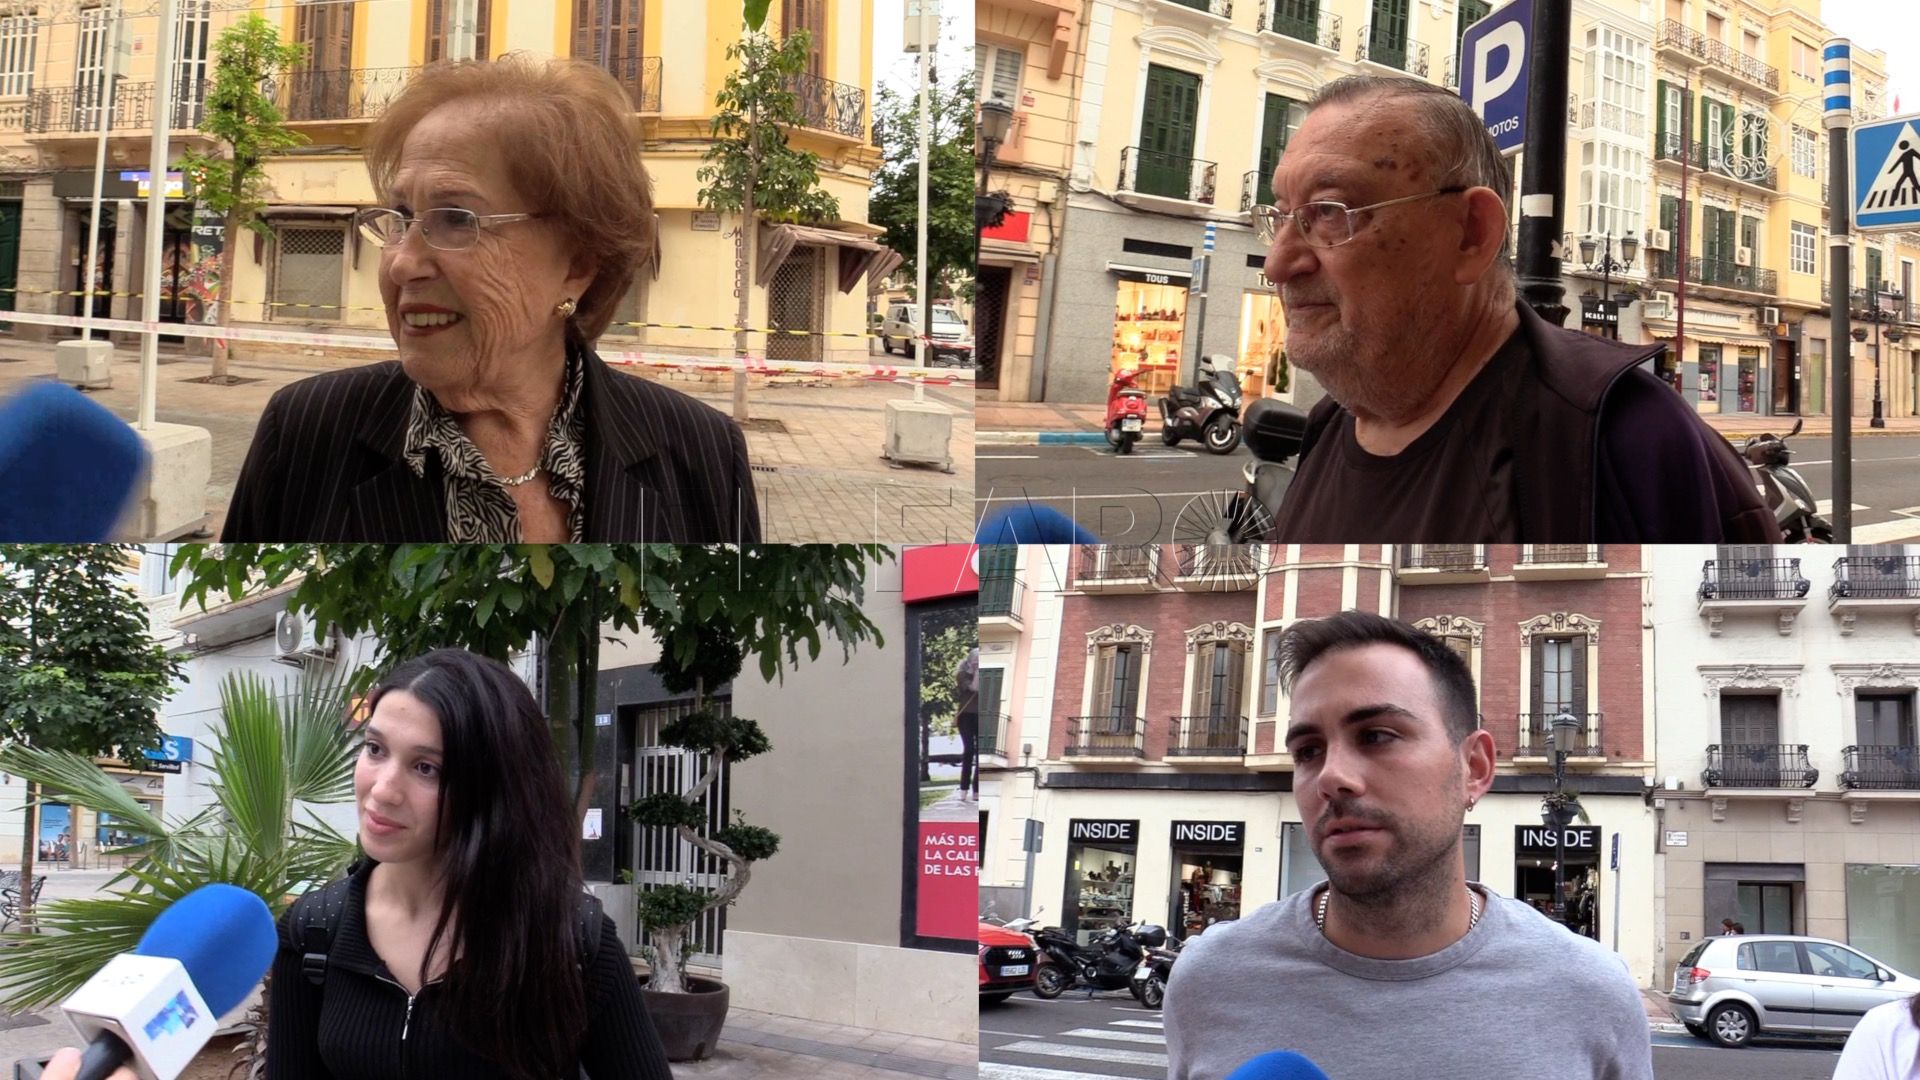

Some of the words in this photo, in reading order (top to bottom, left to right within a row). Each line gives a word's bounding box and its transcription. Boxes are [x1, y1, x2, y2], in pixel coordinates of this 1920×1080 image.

[1471, 20, 1525, 121] P
[1145, 273, 1169, 284] TOUS
[1073, 822, 1131, 839] INSIDE
[1176, 824, 1237, 841] INSIDE
[1523, 829, 1592, 847] INSDE
[925, 832, 955, 846] MÁS
[958, 835, 976, 847] DE
[924, 849, 943, 860] LA
[946, 850, 979, 862] CALI
[924, 864, 942, 875] DE
[945, 865, 971, 877] LAS
